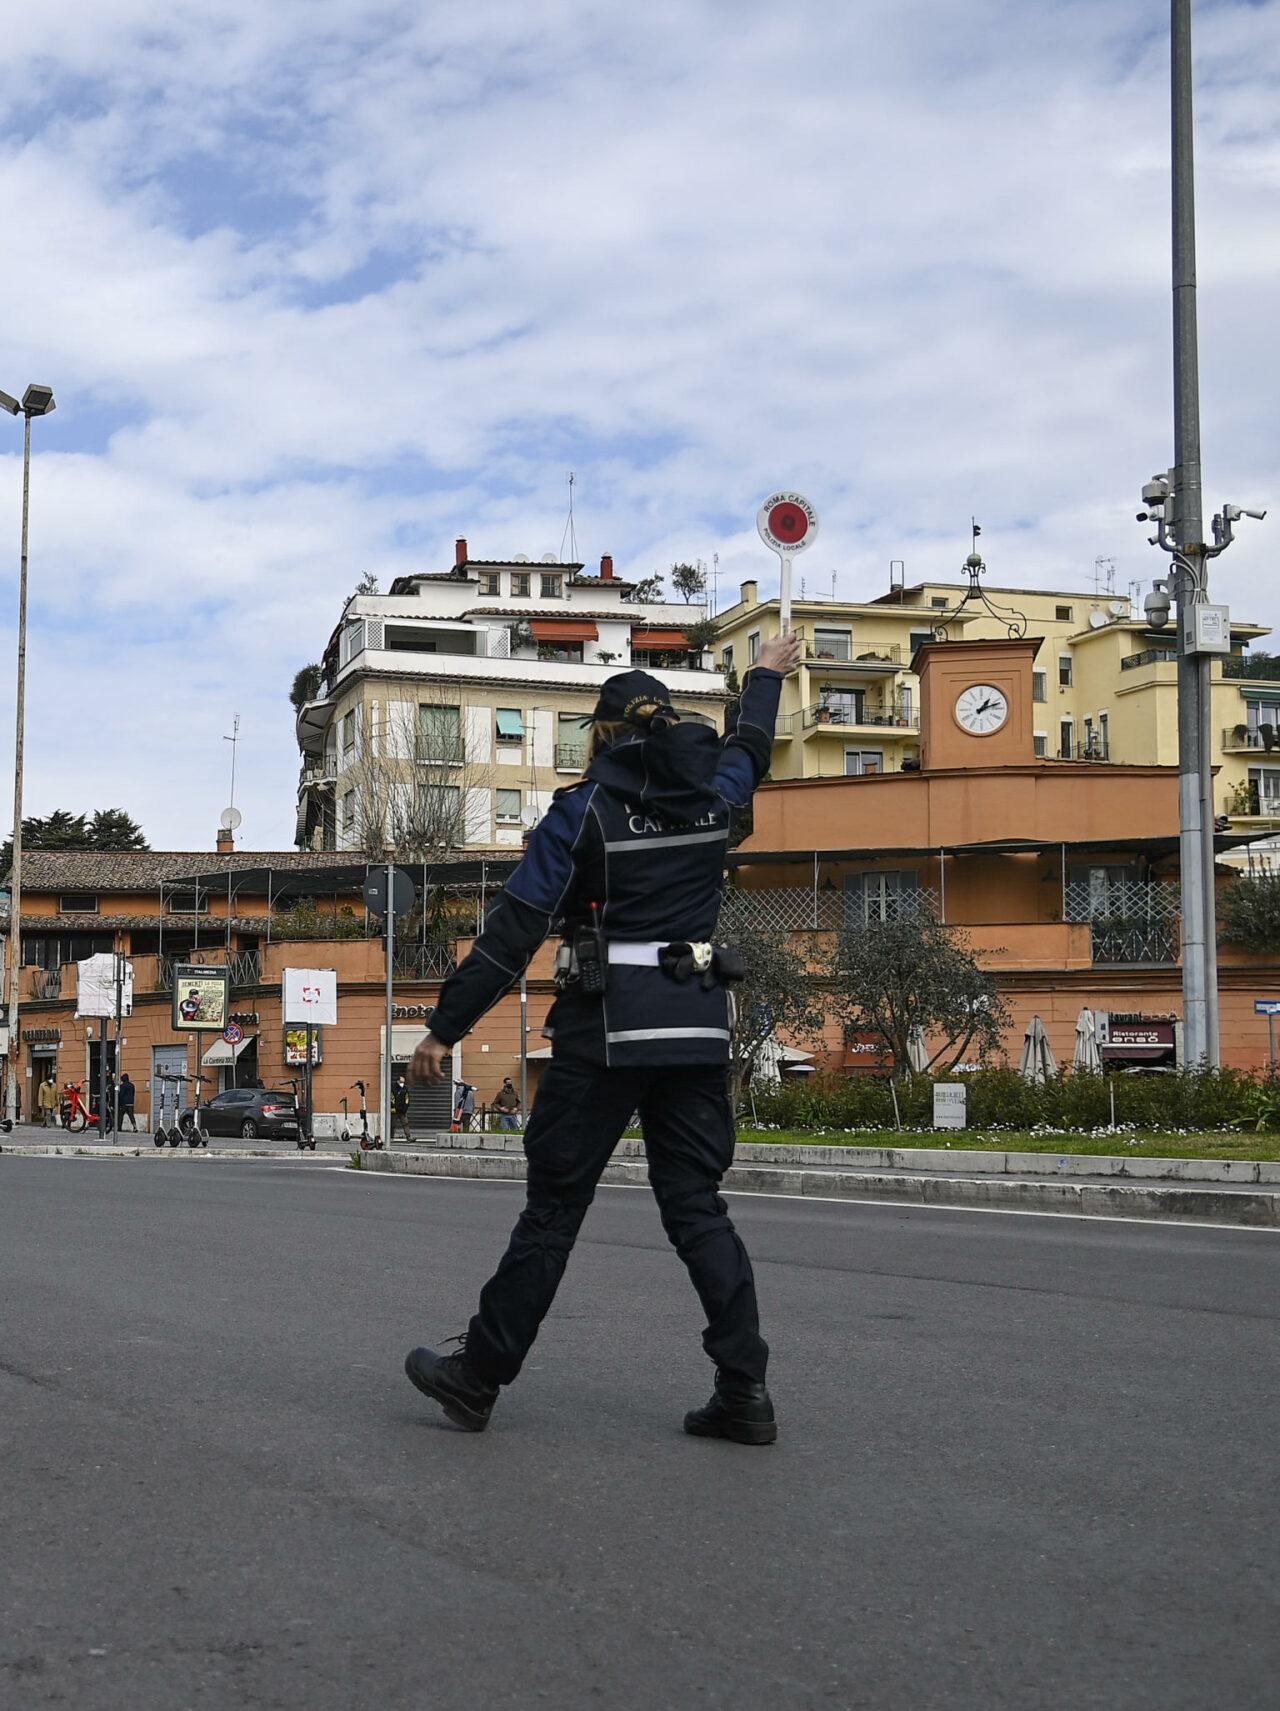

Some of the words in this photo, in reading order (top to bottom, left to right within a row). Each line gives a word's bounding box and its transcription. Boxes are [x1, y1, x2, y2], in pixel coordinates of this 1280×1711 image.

[763, 494, 786, 513] ROMA
[787, 494, 816, 528] CAPITALE
[782, 540, 807, 551] LOCALE
